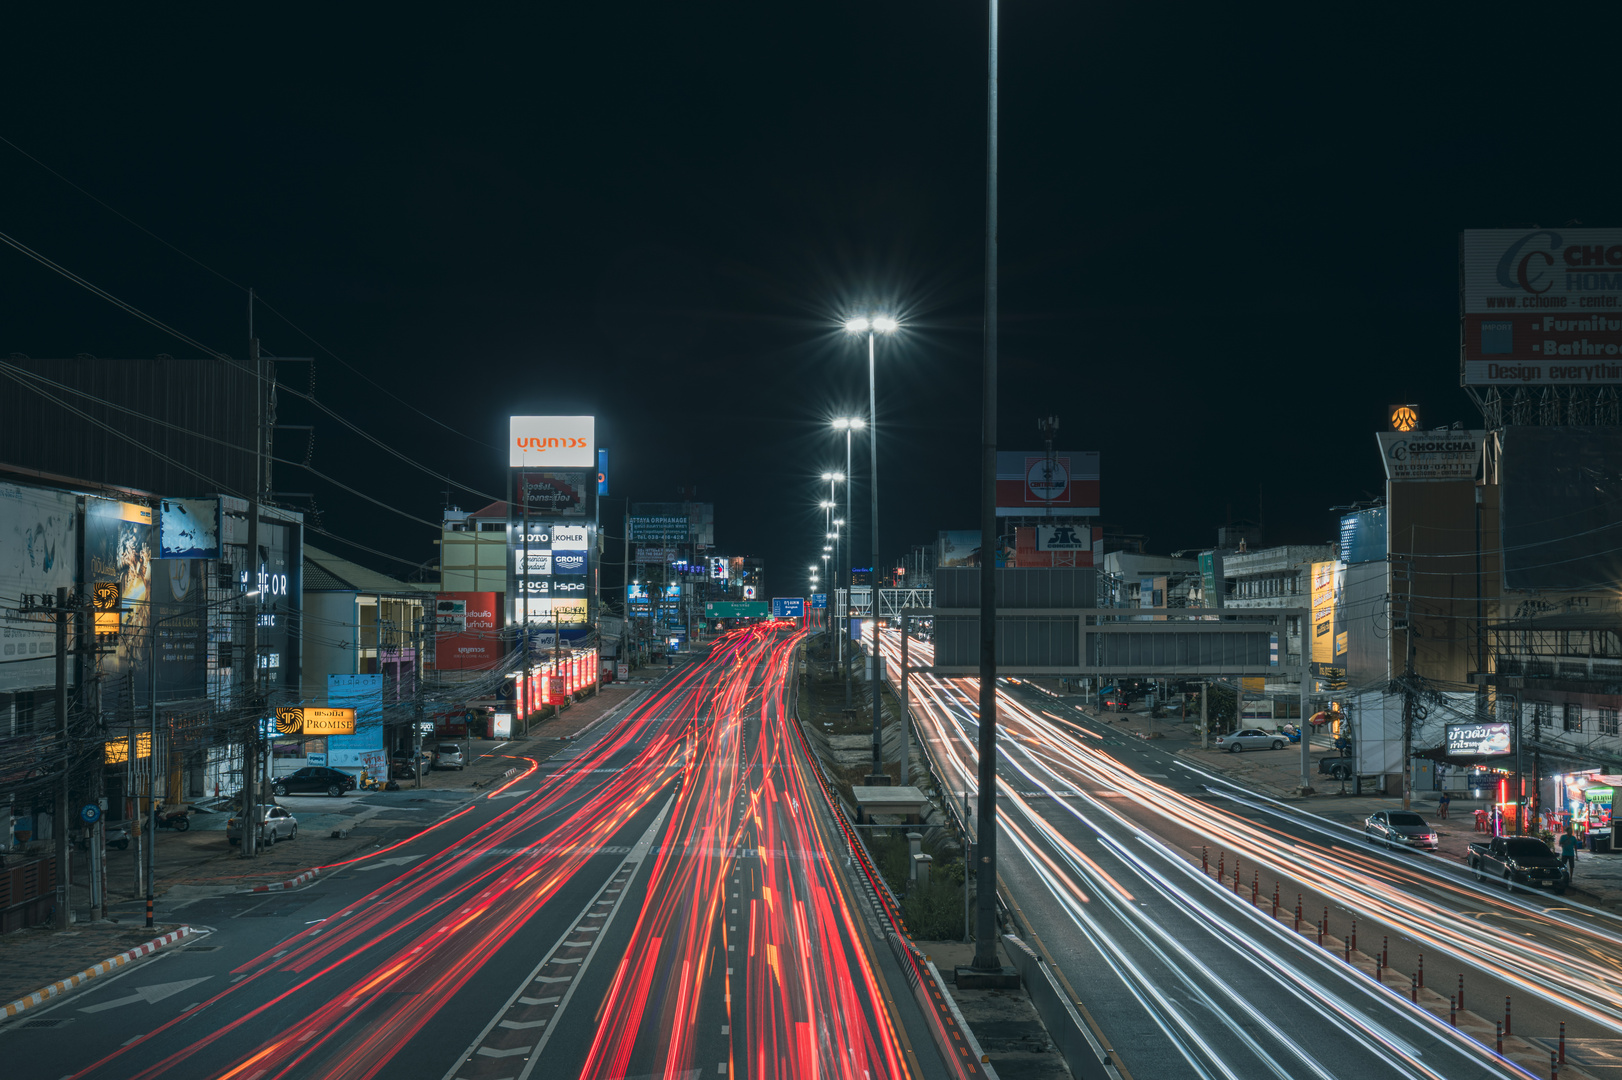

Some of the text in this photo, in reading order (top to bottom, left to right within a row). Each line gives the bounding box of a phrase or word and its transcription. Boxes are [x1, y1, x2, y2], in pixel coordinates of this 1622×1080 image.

[1543, 315, 1622, 332] Furnitu
[1488, 363, 1541, 381] Design
[1409, 442, 1476, 451] CHOKCHAI
[306, 720, 353, 729] PROMISE
[1449, 725, 1491, 740] ข้าวต้ม
